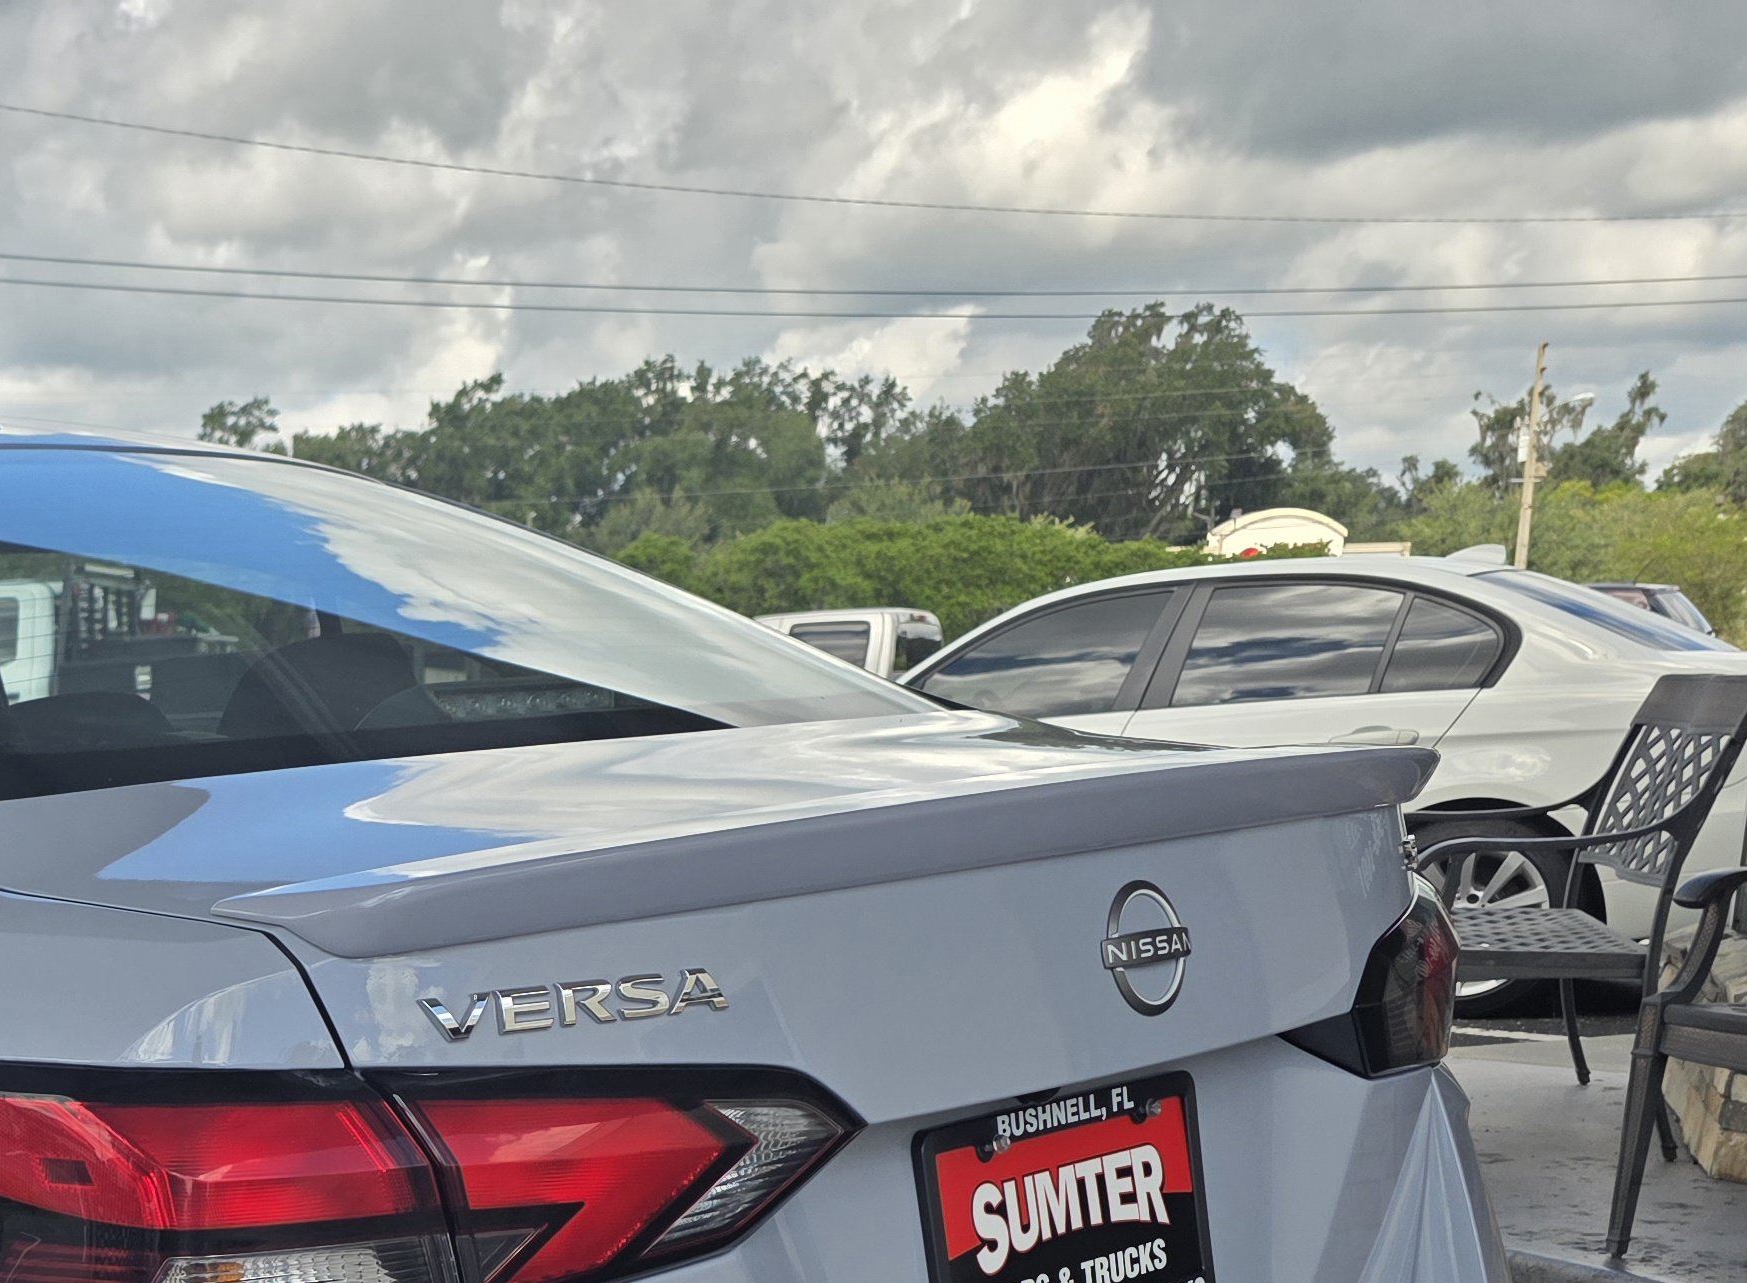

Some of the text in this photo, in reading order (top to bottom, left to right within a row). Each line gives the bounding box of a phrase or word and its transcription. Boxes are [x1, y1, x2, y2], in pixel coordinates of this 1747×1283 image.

[1106, 932, 1192, 963] NISSAN
[416, 967, 730, 1043] VERSA
[1111, 1086, 1134, 1111] FL
[971, 1143, 1170, 1276] SUMTER
